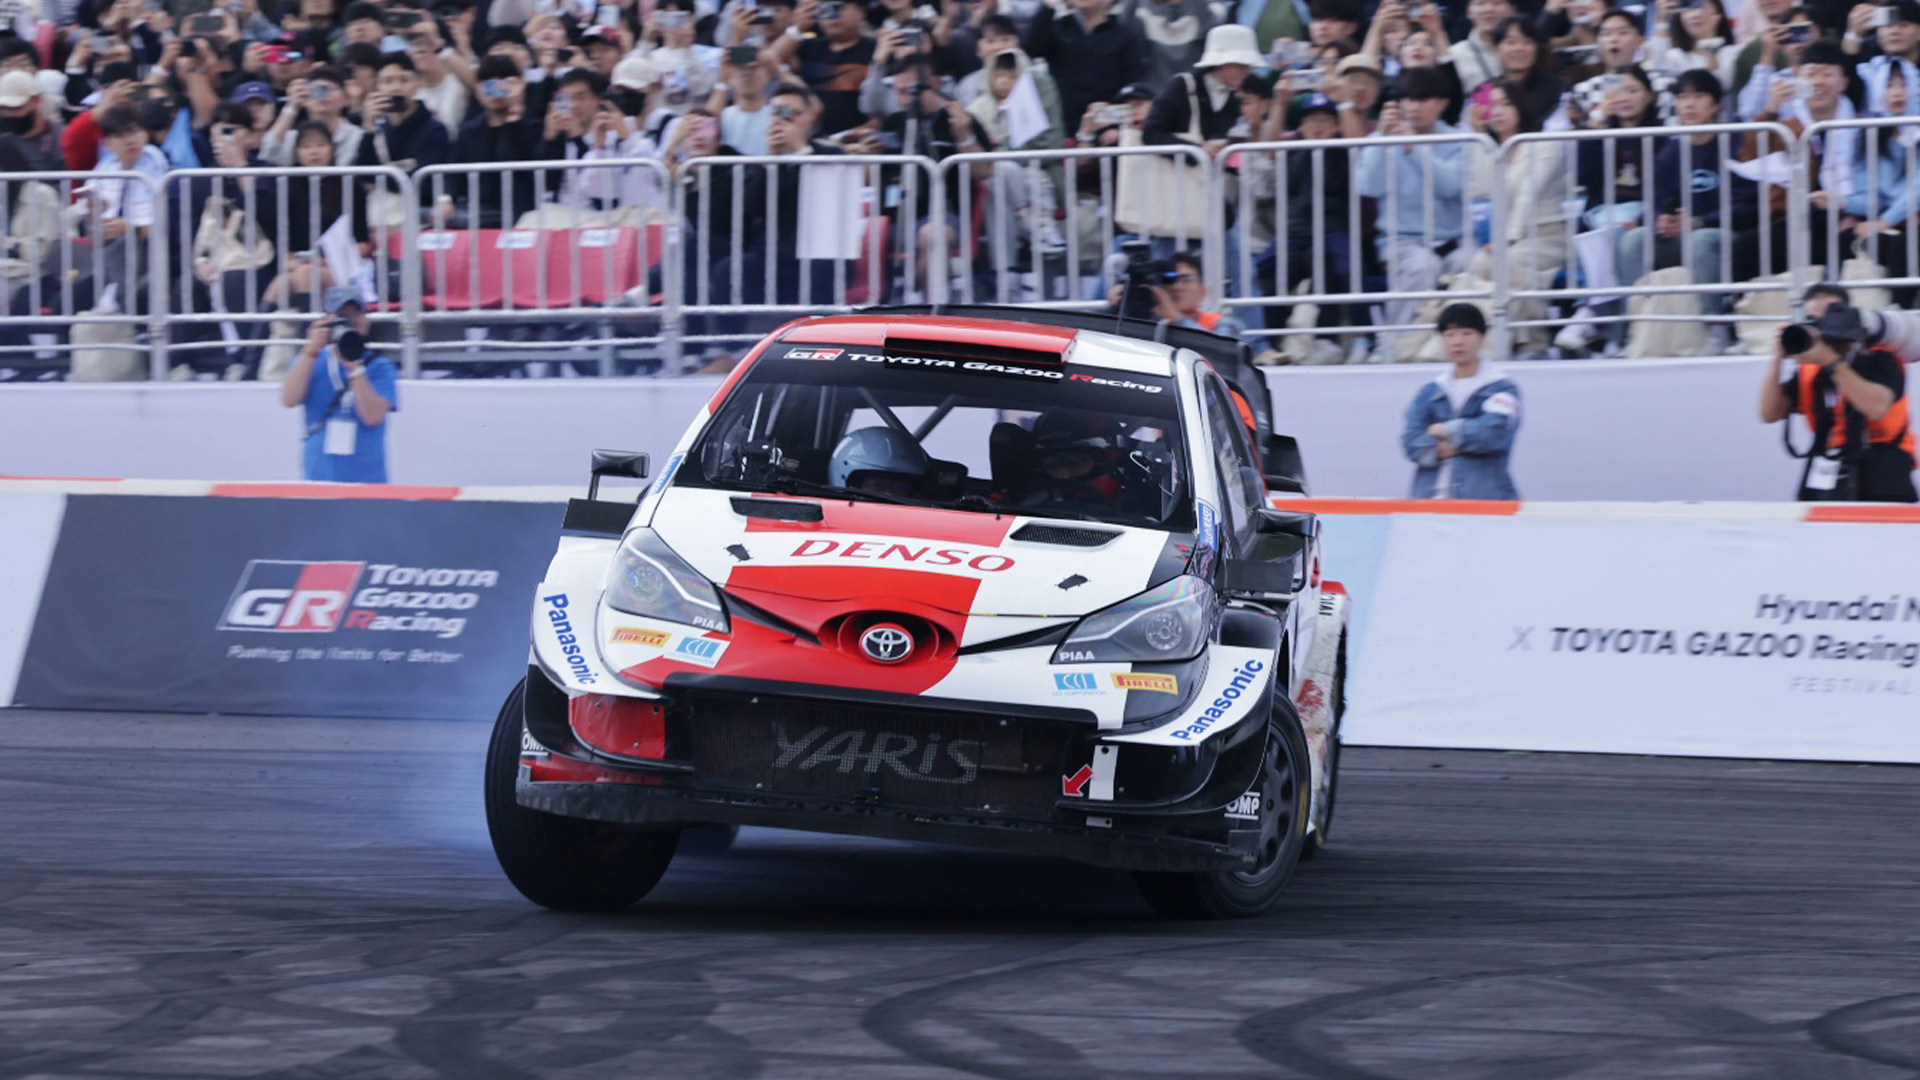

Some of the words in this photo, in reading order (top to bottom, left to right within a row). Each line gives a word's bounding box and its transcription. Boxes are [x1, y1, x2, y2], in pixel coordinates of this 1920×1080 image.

[784, 351, 837, 360] GR
[848, 353, 956, 368] TOYOTA
[962, 361, 1065, 380] GAZOO
[1069, 373, 1163, 394] Racing
[790, 540, 1016, 571] DENSO
[367, 564, 499, 587] TOYOTA
[227, 588, 347, 627] GR
[352, 587, 479, 610] GAZOO
[1755, 594, 1900, 625] Hyundai
[343, 610, 467, 639] Racing
[612, 629, 667, 645] PIRELLI
[692, 616, 724, 632] PIAA
[543, 593, 599, 685] Panasonic
[1508, 626, 1536, 651] X
[1551, 627, 1678, 655] TOYOTA
[1685, 630, 1804, 658] GAZOO
[1808, 634, 1920, 668] Racing
[1059, 651, 1095, 661] PIAA
[1116, 675, 1173, 691] PIRELLI
[1789, 676, 1914, 695] FESTIVAL
[1170, 659, 1264, 741] Panasonic
[1226, 795, 1260, 815] OMP
